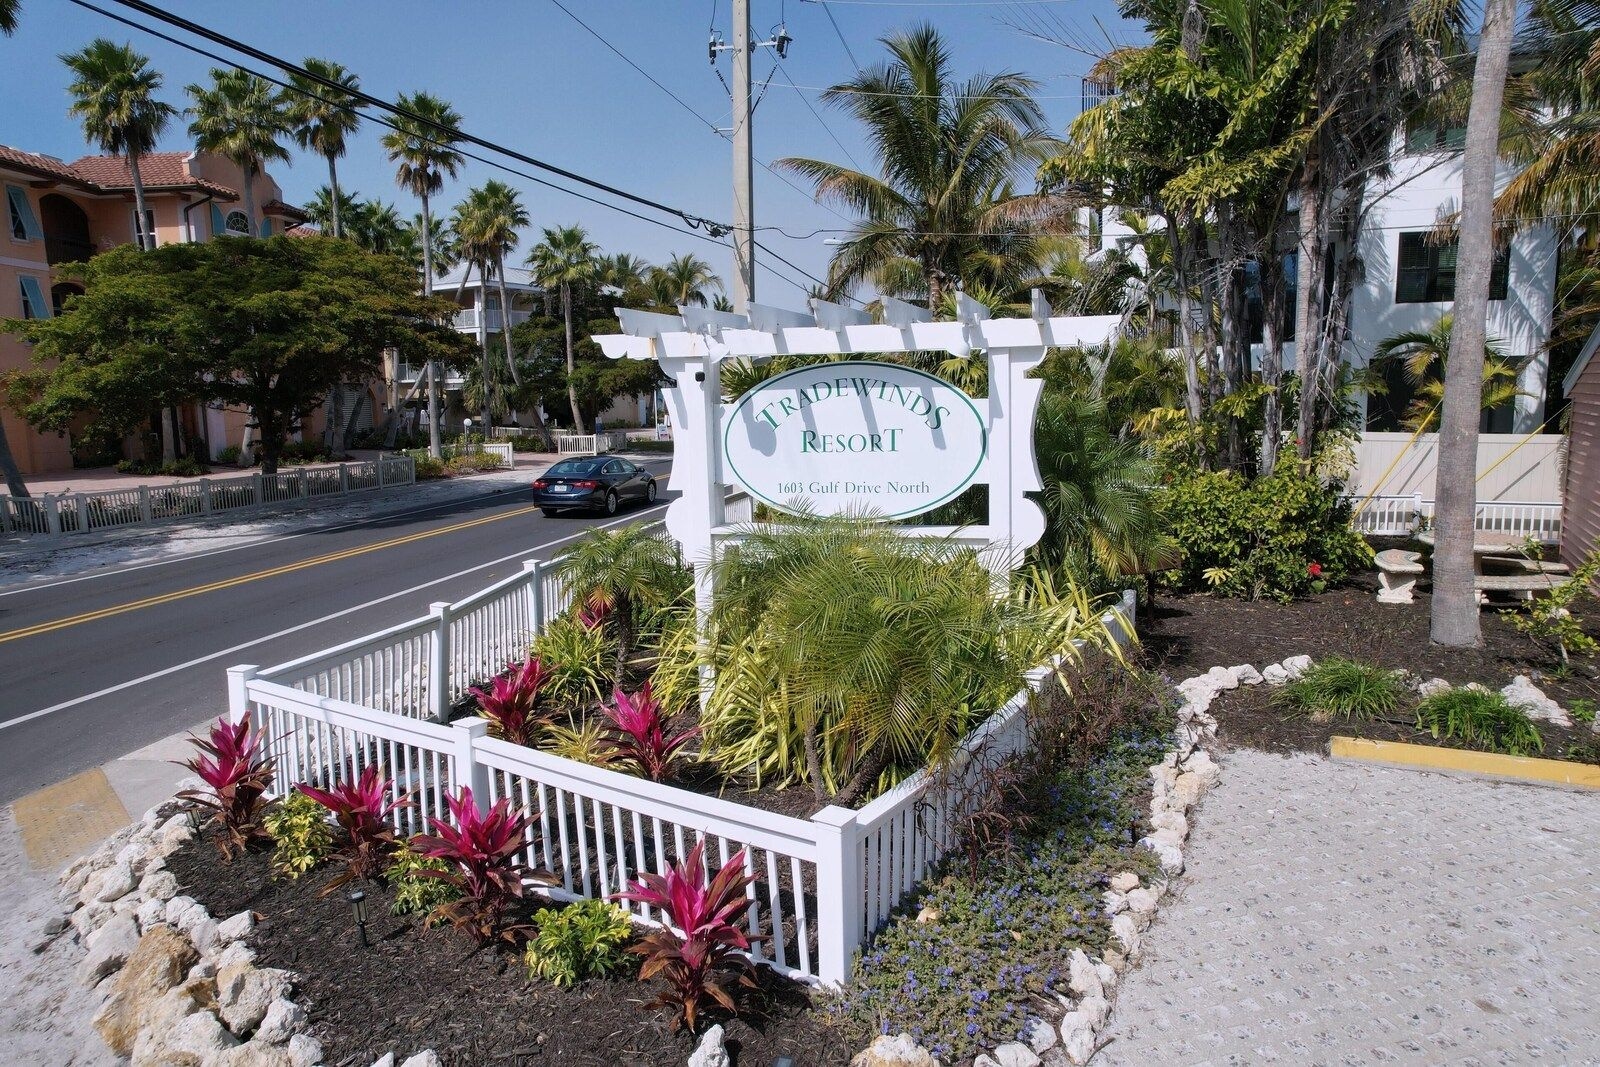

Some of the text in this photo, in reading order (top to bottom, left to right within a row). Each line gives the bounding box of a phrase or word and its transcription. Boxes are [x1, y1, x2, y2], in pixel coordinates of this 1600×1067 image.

[755, 377, 951, 432] TRADEWINDS
[800, 428, 903, 453] RESORT
[777, 481, 930, 494] 1603 Gulf Drive North
